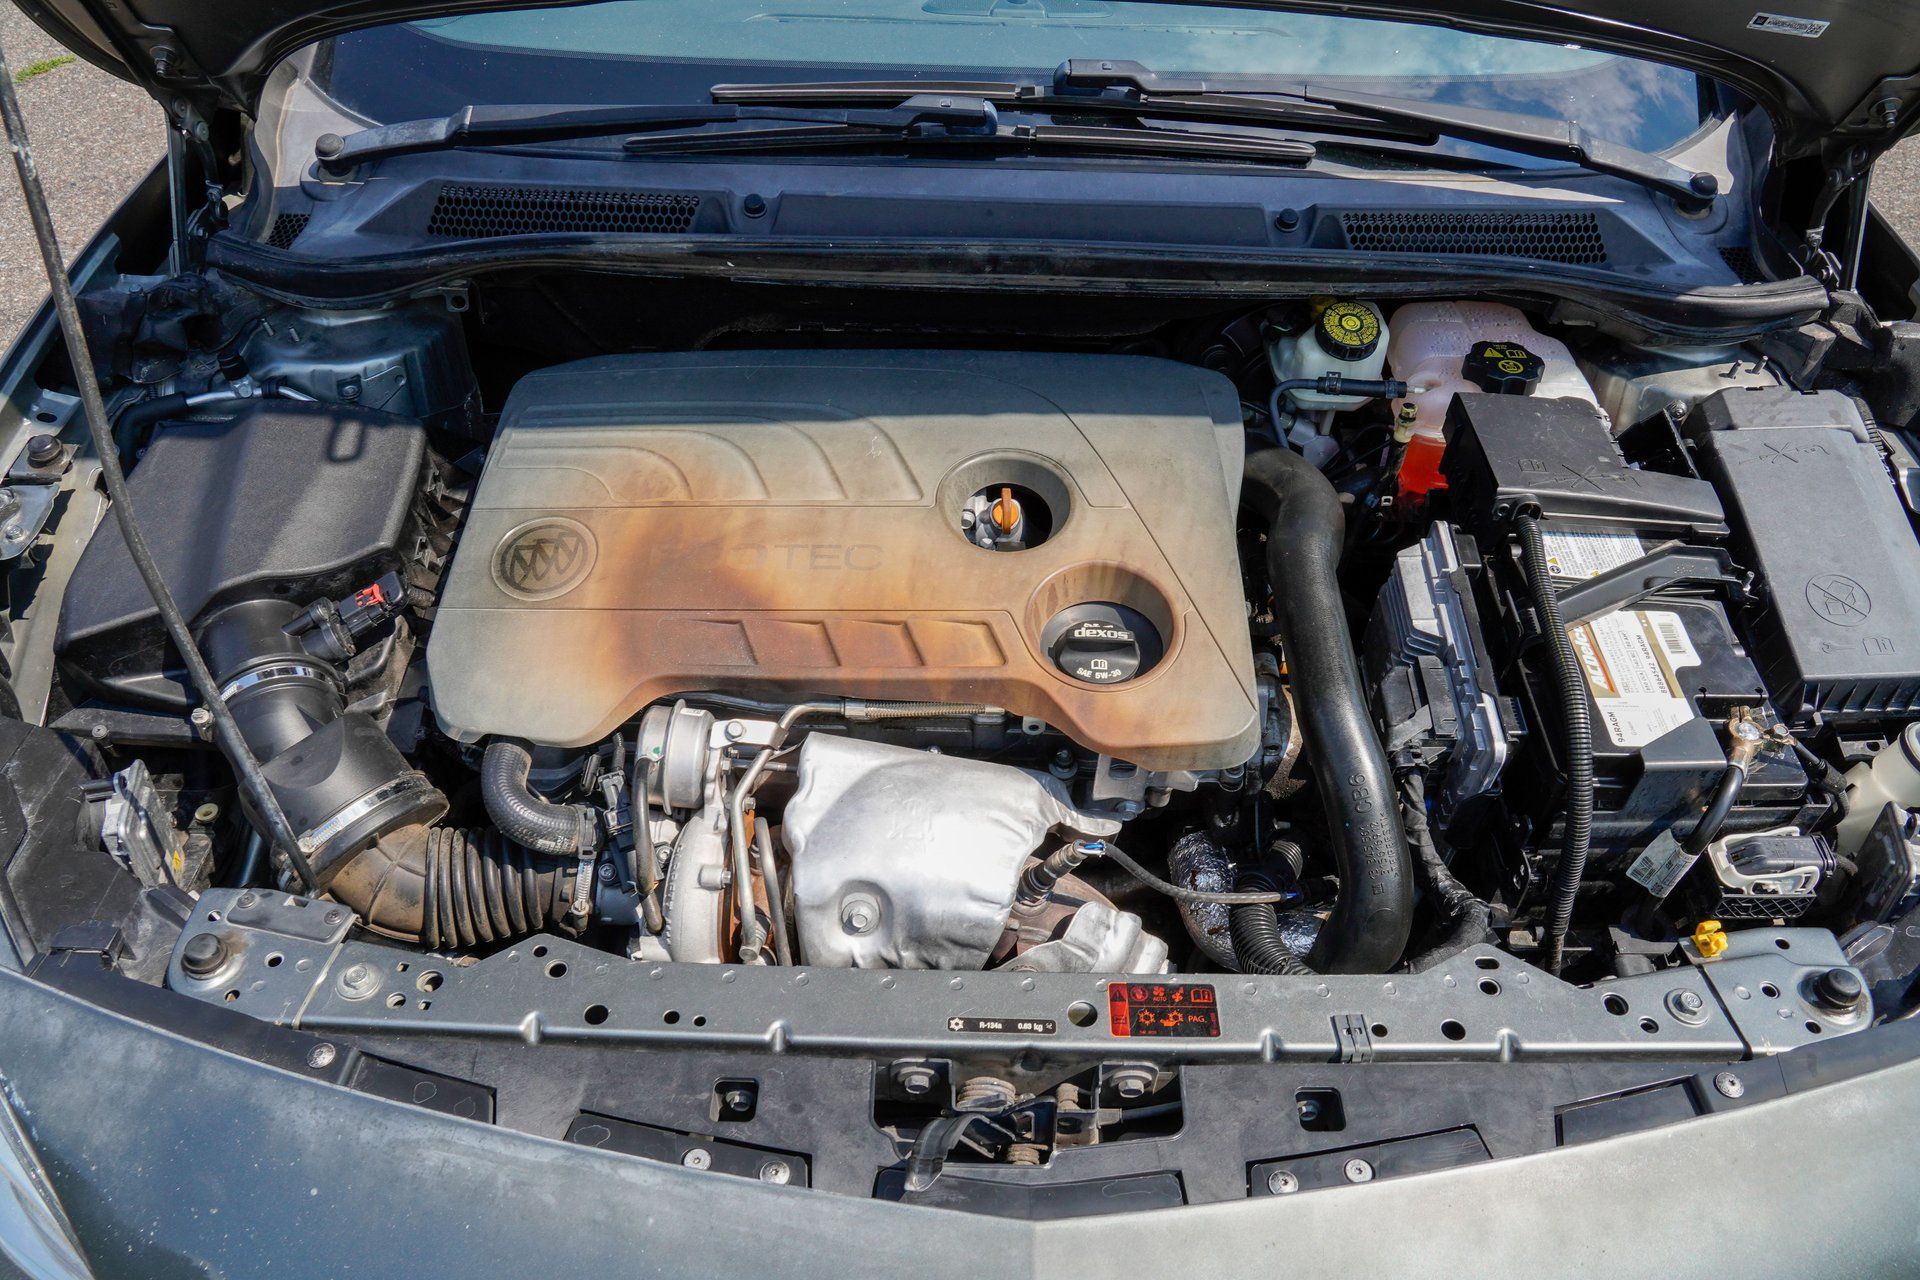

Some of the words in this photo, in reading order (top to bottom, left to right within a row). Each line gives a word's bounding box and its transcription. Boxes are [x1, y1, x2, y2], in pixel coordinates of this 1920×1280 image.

[1074, 627, 1128, 640] dexos
[1077, 667, 1092, 678] SAE
[1095, 668, 1121, 679] 5W-30
[1607, 710, 1625, 743] 94RAGM
[1348, 773, 1372, 813] CB6
[979, 1021, 1002, 1030] R-134a
[1033, 1022, 1044, 1032] kg
